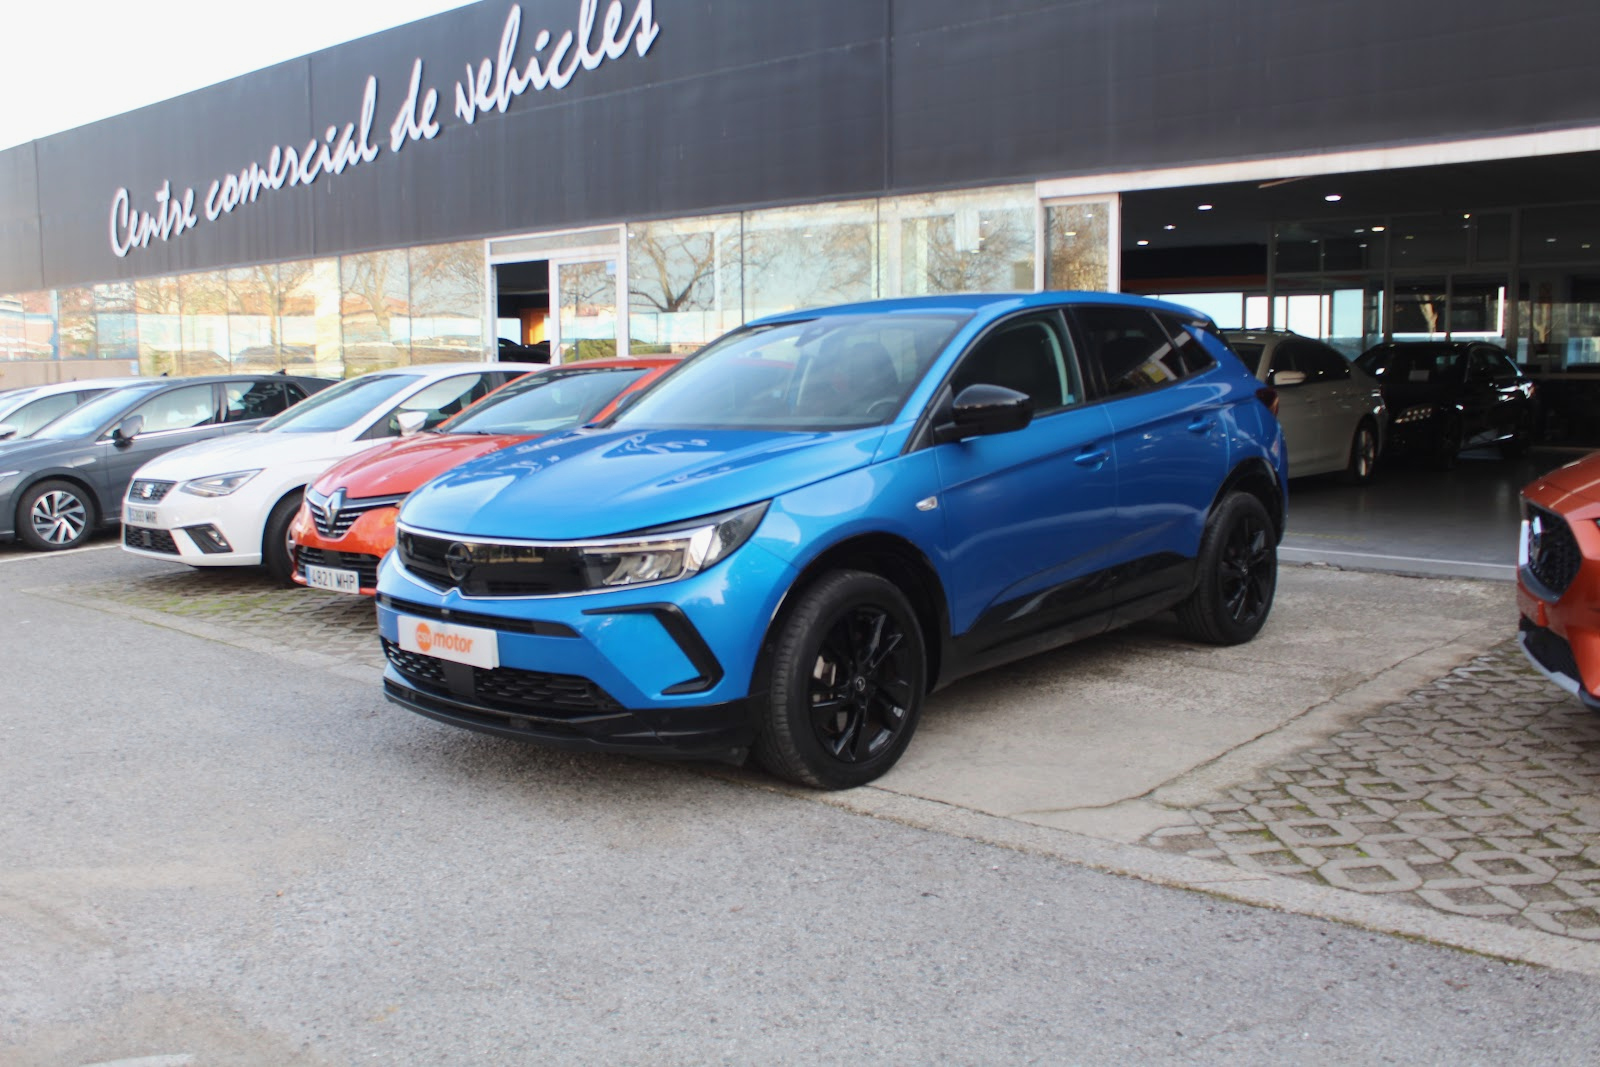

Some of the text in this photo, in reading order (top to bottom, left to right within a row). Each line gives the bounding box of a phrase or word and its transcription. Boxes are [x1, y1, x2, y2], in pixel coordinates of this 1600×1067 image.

[109, 0, 660, 257] Centre comercial de vehicles
[433, 631, 474, 653] motor
